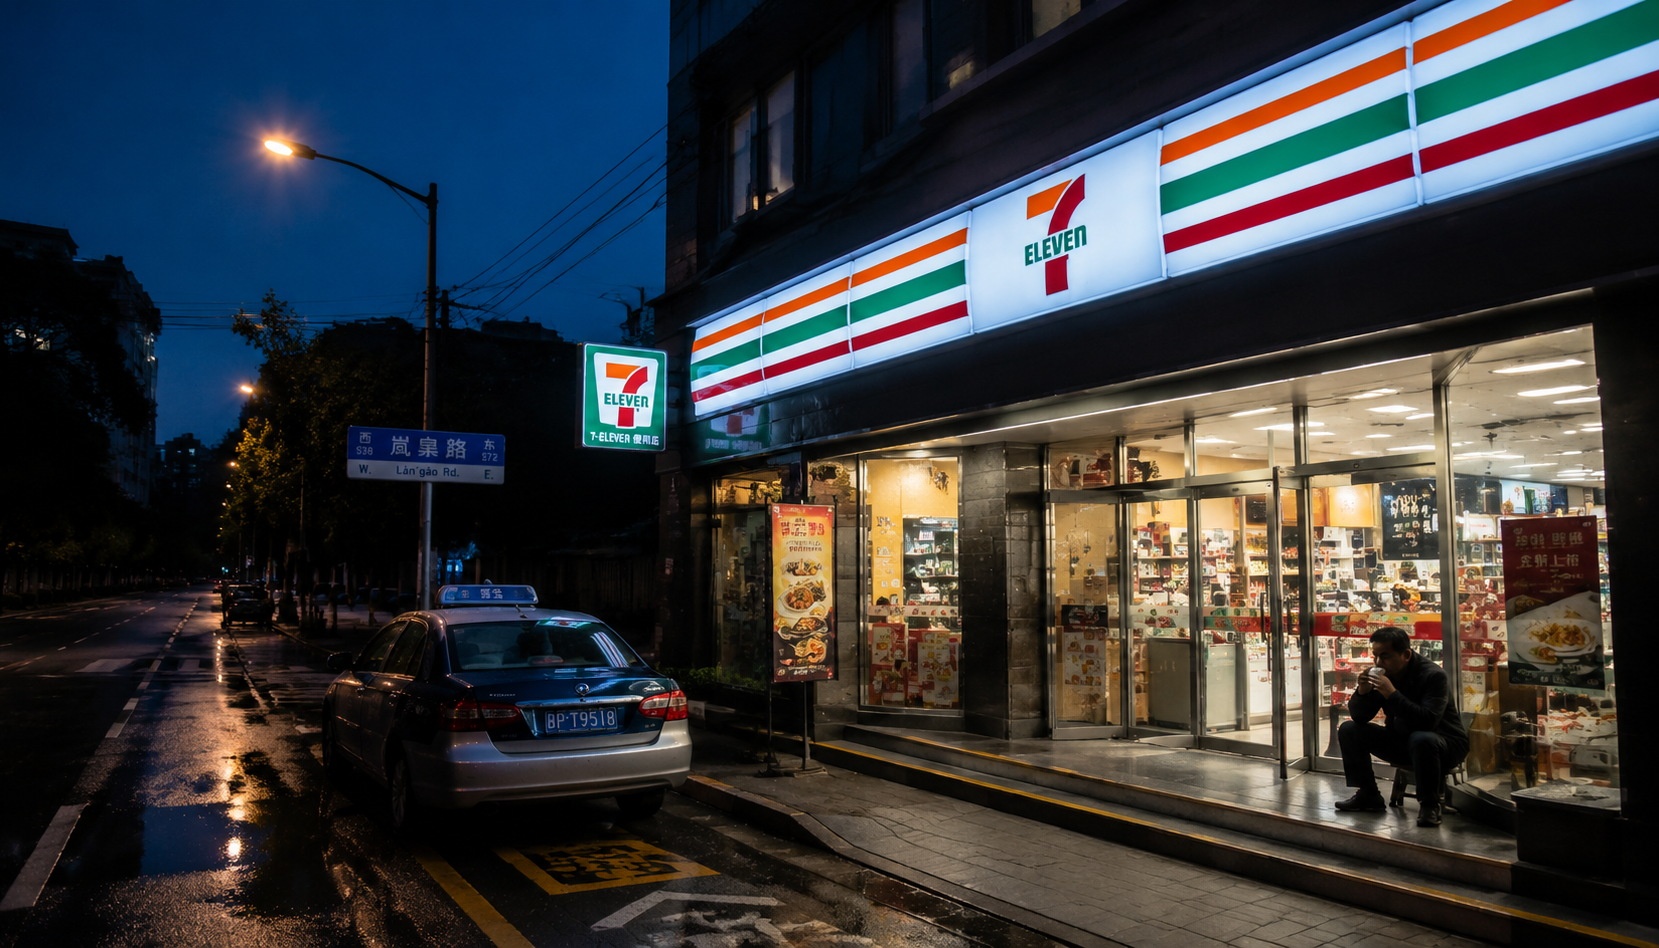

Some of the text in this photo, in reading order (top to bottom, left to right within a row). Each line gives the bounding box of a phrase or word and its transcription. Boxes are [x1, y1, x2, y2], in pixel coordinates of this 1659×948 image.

[1027, 173, 1086, 296] 7
[606, 362, 648, 427] 7
[359, 431, 372, 444] 西
[356, 445, 373, 456] S38
[358, 464, 372, 475] W.
[443, 467, 460, 477] Rd.
[484, 469, 494, 480] E.
